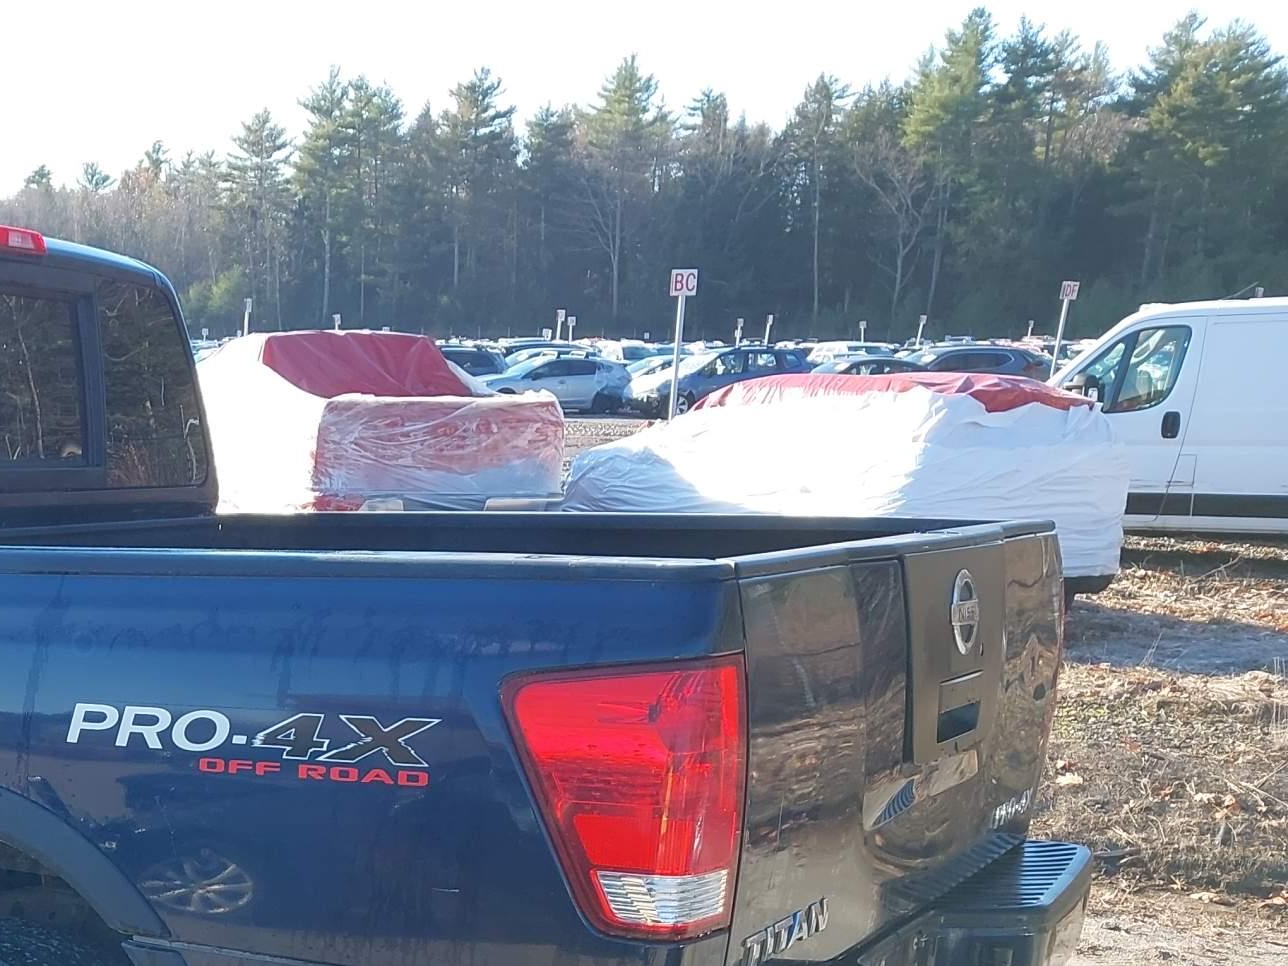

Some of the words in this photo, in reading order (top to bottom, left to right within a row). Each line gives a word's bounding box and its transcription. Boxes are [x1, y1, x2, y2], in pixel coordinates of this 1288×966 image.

[674, 272, 697, 292] BC
[198, 757, 281, 776] OFF
[297, 763, 429, 787] ROAD
